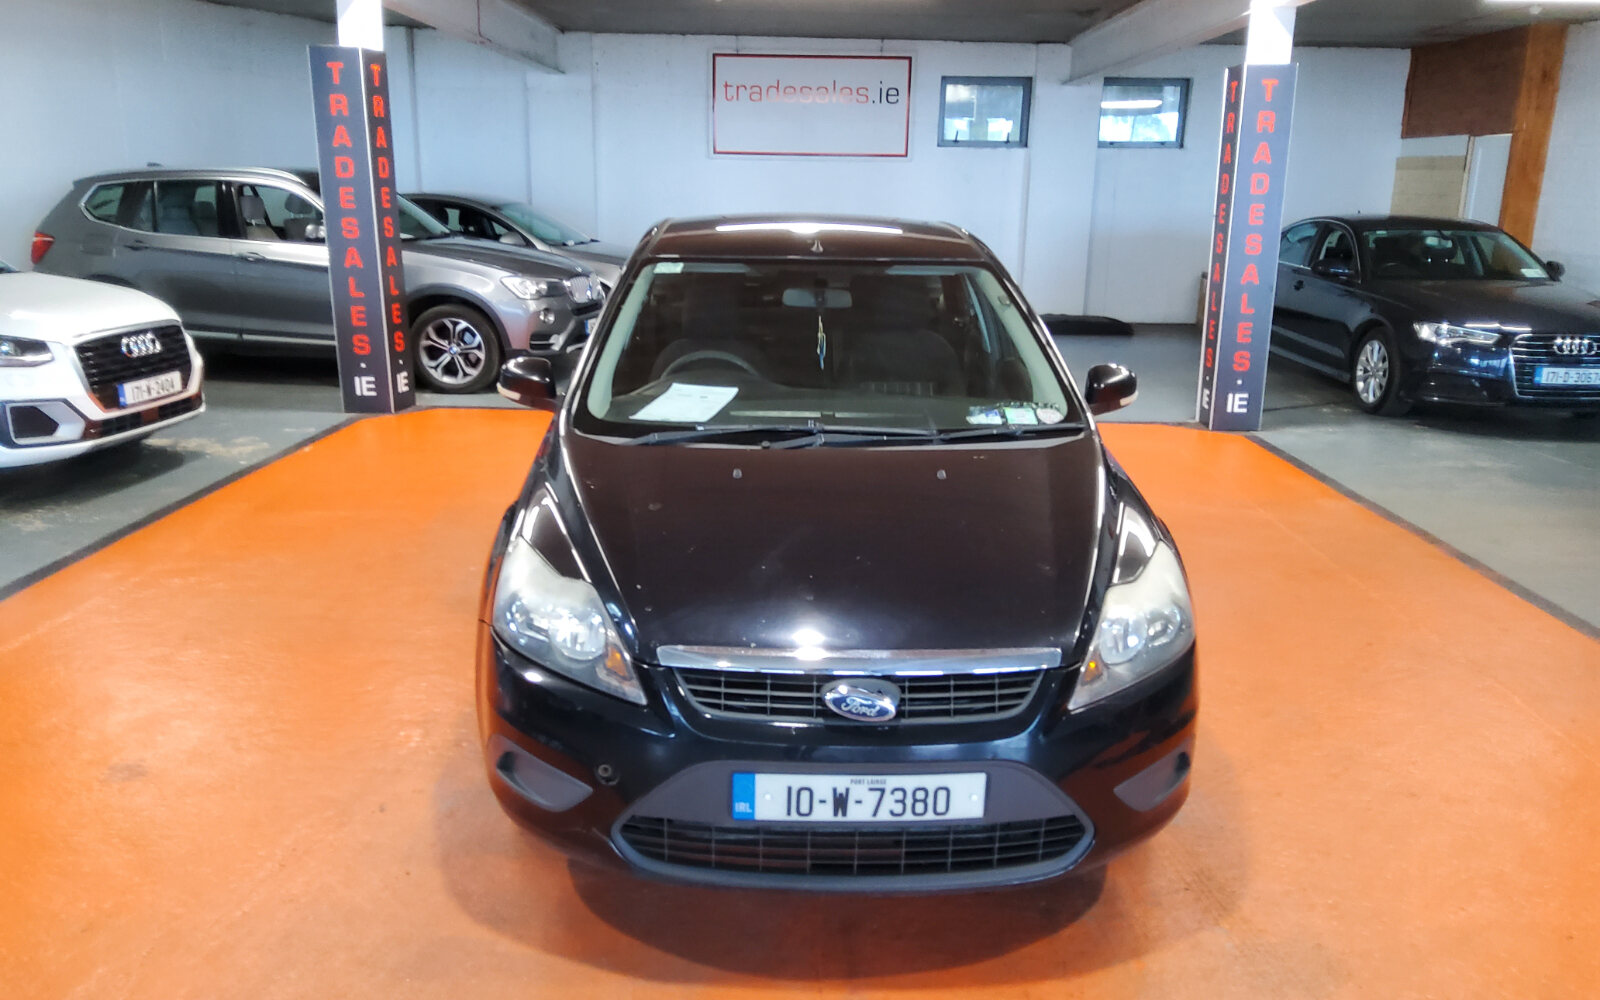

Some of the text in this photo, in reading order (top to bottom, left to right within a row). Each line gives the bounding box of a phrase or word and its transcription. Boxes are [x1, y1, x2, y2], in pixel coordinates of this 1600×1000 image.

[723, 80, 900, 104] tradesales.ie
[840, 696, 880, 716] Ford
[735, 802, 752, 812] IRL
[786, 786, 951, 817] 10-W-7380
